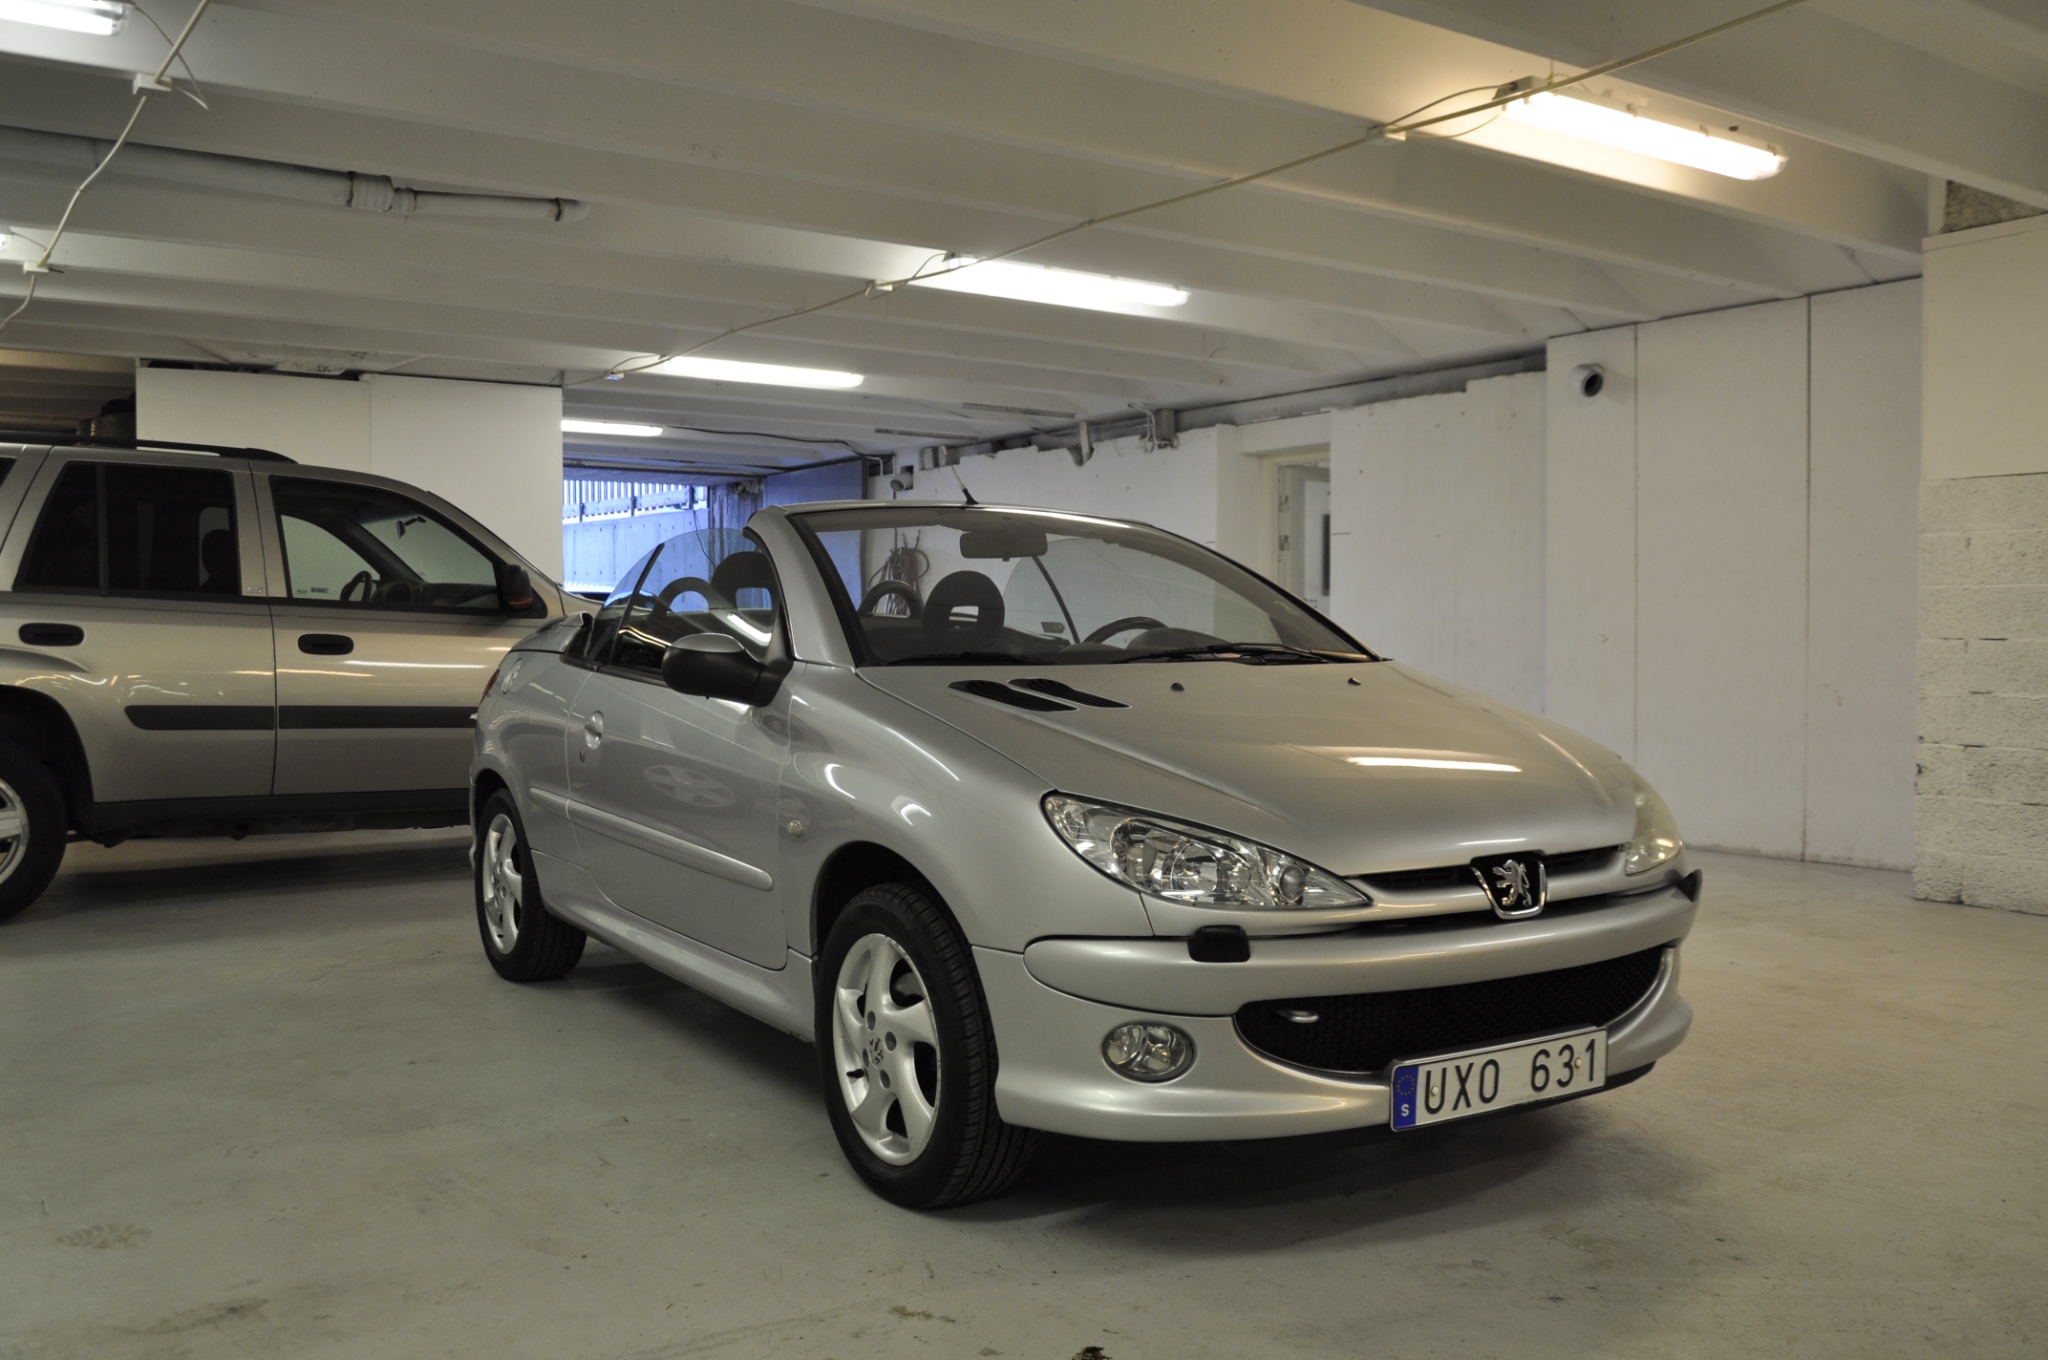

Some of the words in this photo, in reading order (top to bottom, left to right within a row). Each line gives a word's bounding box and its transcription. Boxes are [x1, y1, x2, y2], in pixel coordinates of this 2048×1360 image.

[1424, 1058, 1500, 1115] UXO
[1530, 1038, 1596, 1093] 631
[1400, 1103, 1410, 1117] S
